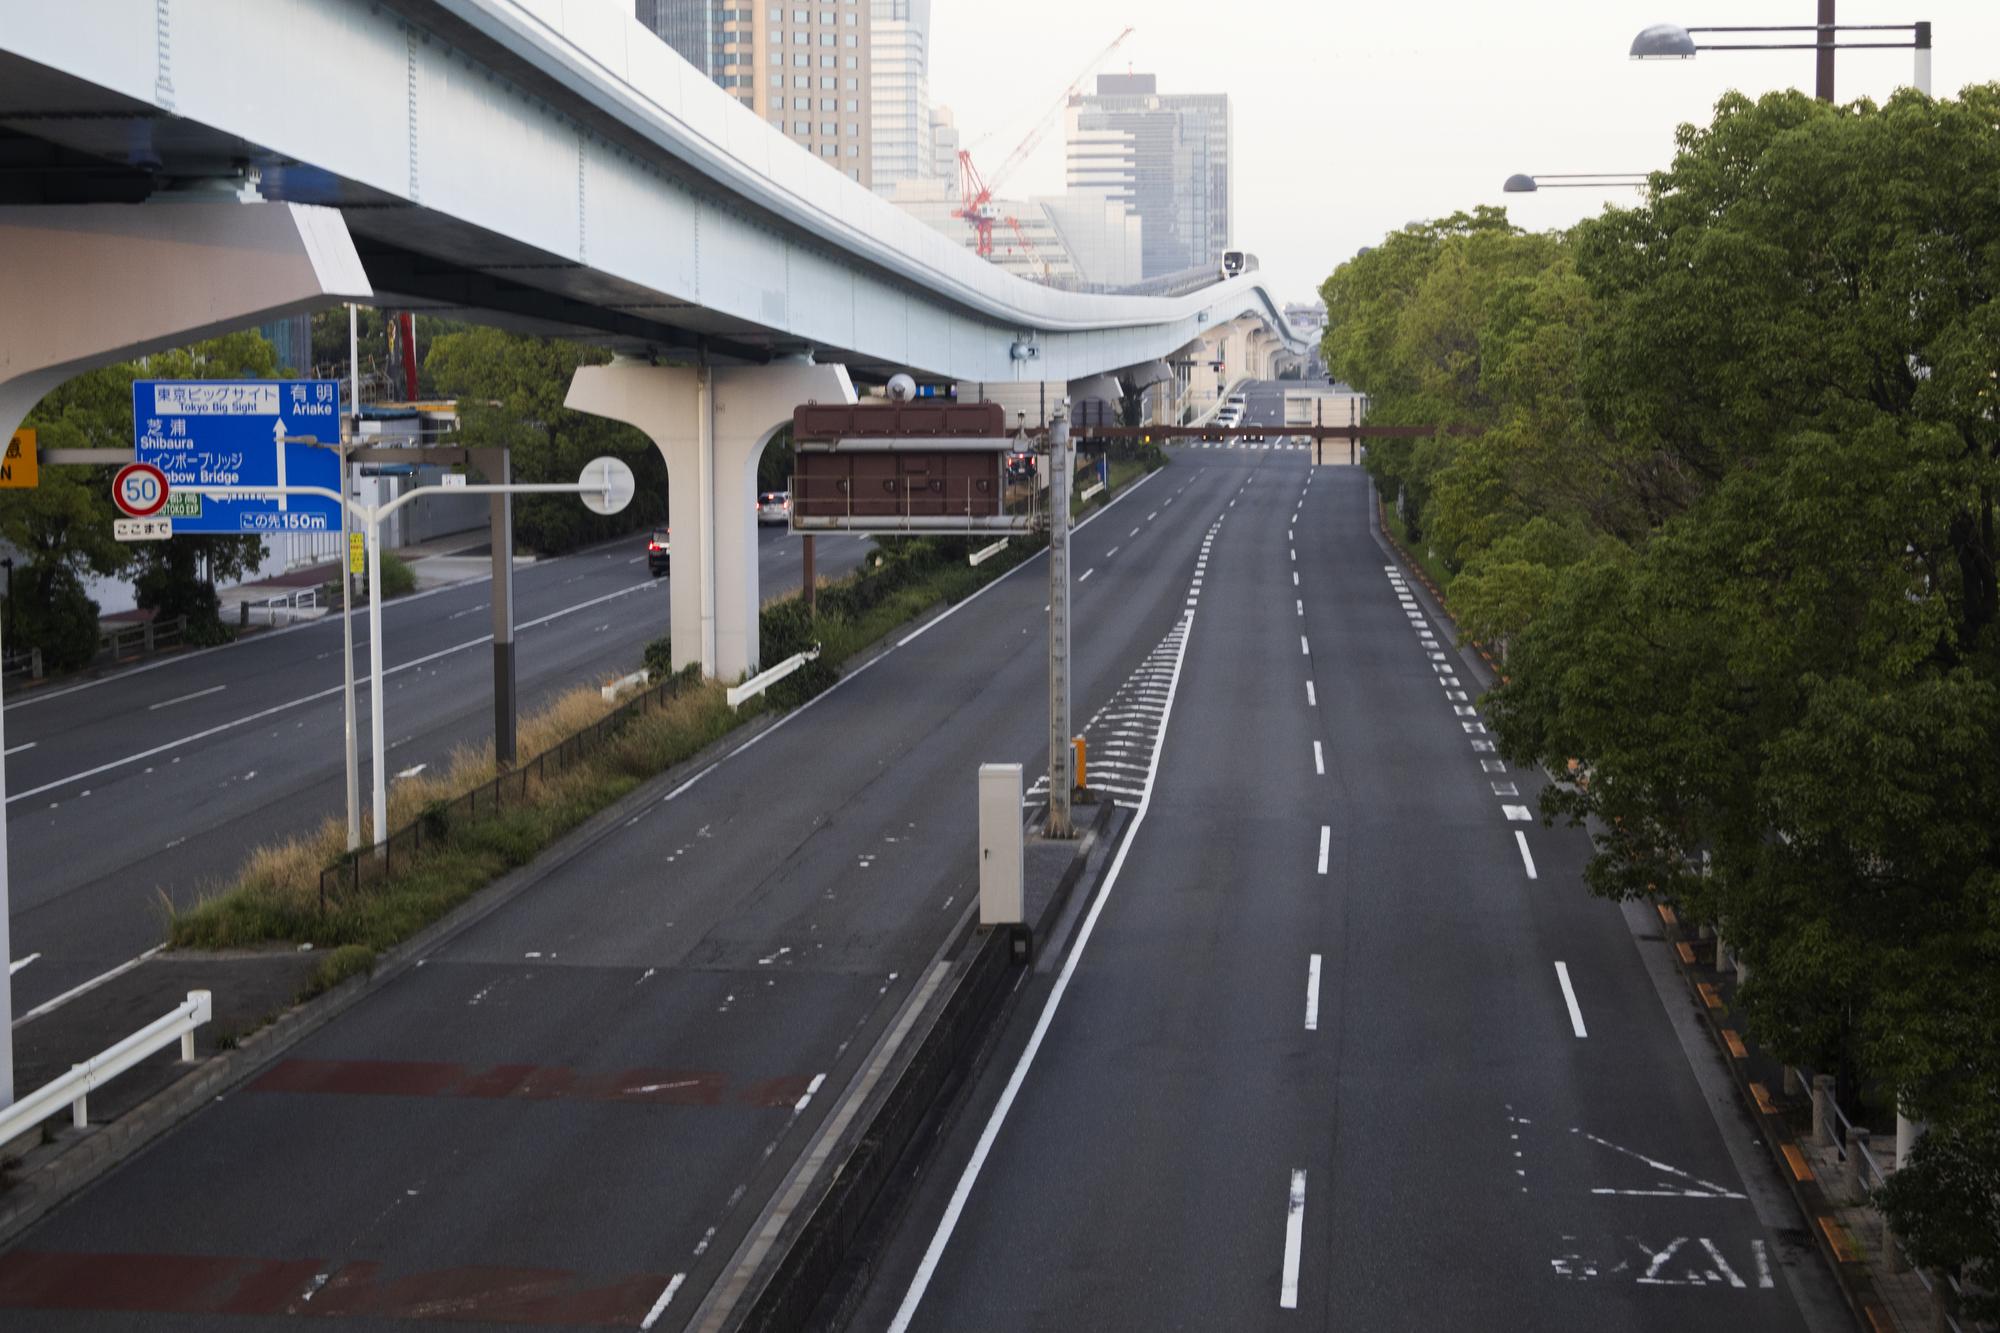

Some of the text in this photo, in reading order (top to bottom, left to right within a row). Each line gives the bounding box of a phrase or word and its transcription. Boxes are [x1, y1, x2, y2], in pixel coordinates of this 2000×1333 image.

[158, 387, 277, 402] 東京ビッグサイト
[290, 384, 333, 401] 有明
[180, 402, 257, 414] Tokyo Big Sight
[292, 402, 332, 416] Ariake
[147, 418, 187, 436] 芝浦
[140, 435, 194, 450] Shibaura
[200, 470, 239, 485] Bridge
[126, 478, 157, 503] 50
[117, 522, 168, 535] ここまで
